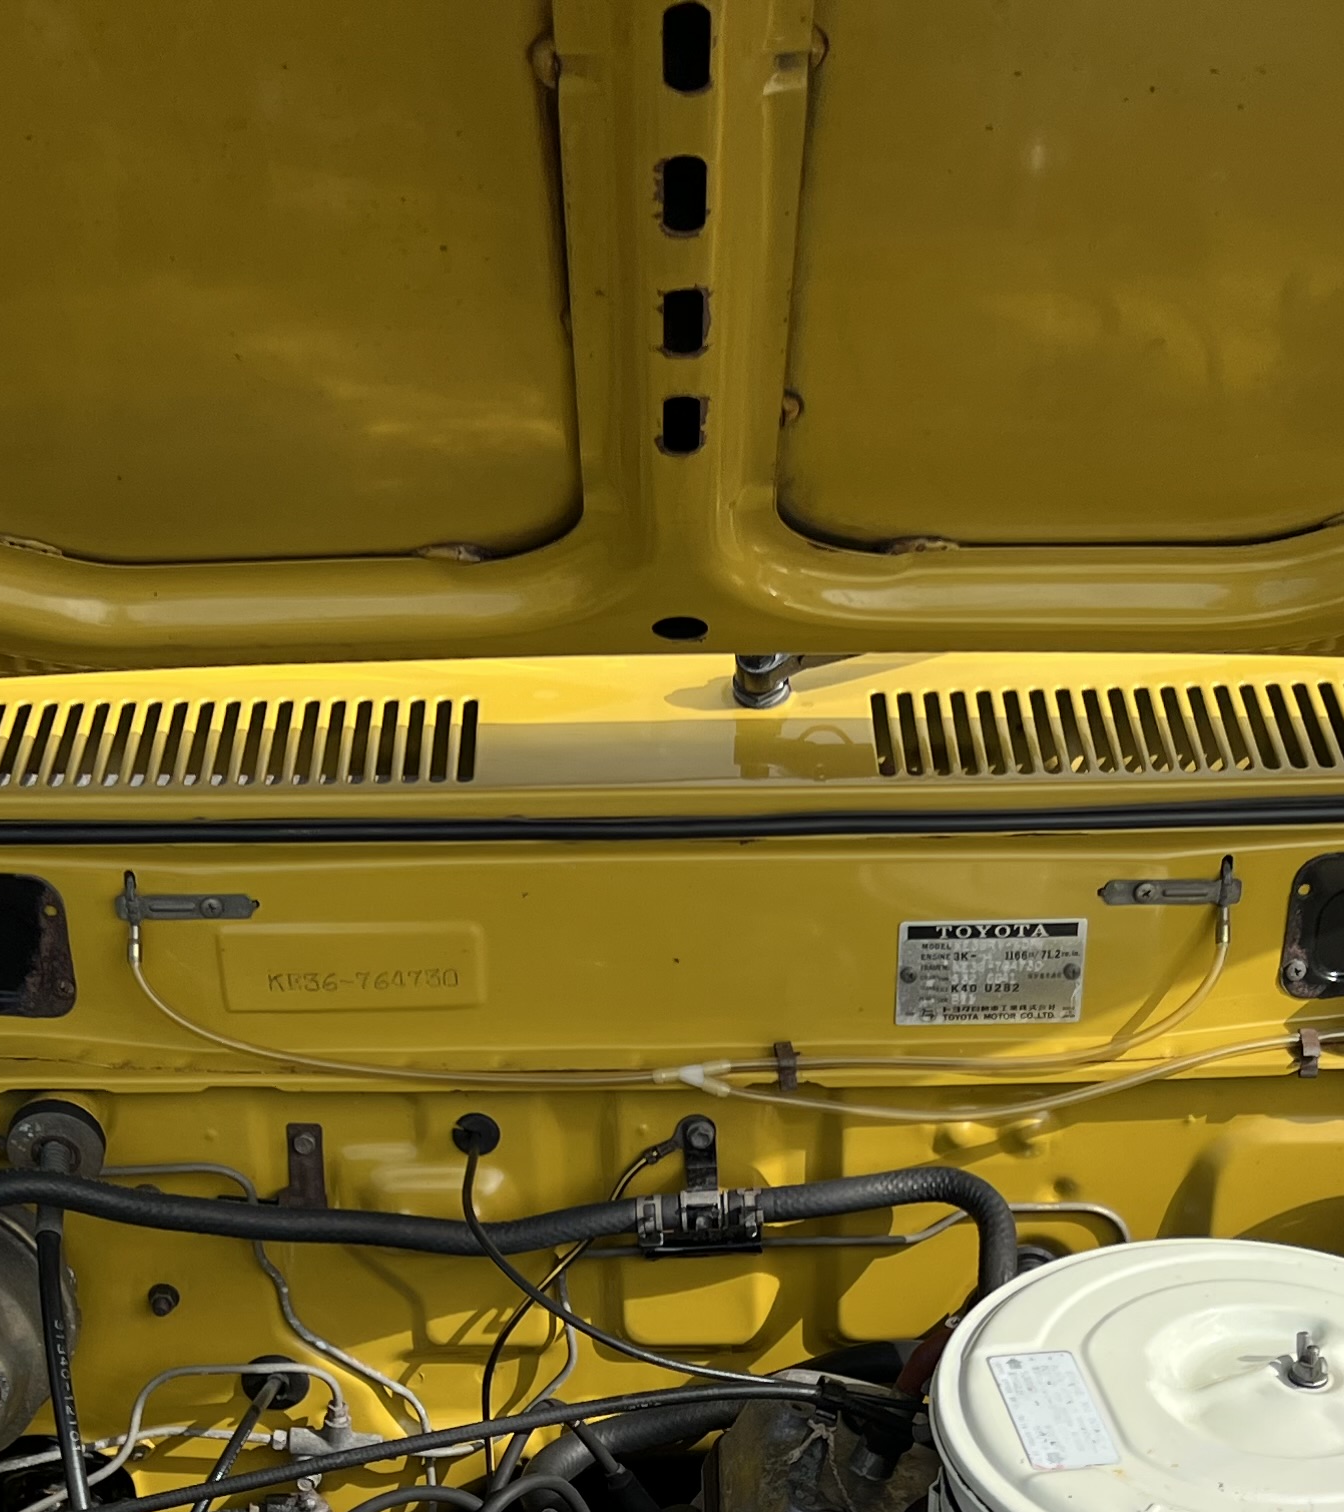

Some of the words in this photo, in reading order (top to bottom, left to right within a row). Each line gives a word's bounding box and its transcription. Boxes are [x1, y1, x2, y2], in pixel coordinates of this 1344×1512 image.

[935, 923, 1050, 939] TOYOTA
[921, 942, 952, 951] MODEL
[942, 1013, 979, 1021] TOYOTA
[983, 1012, 1017, 1021] MOTOR
